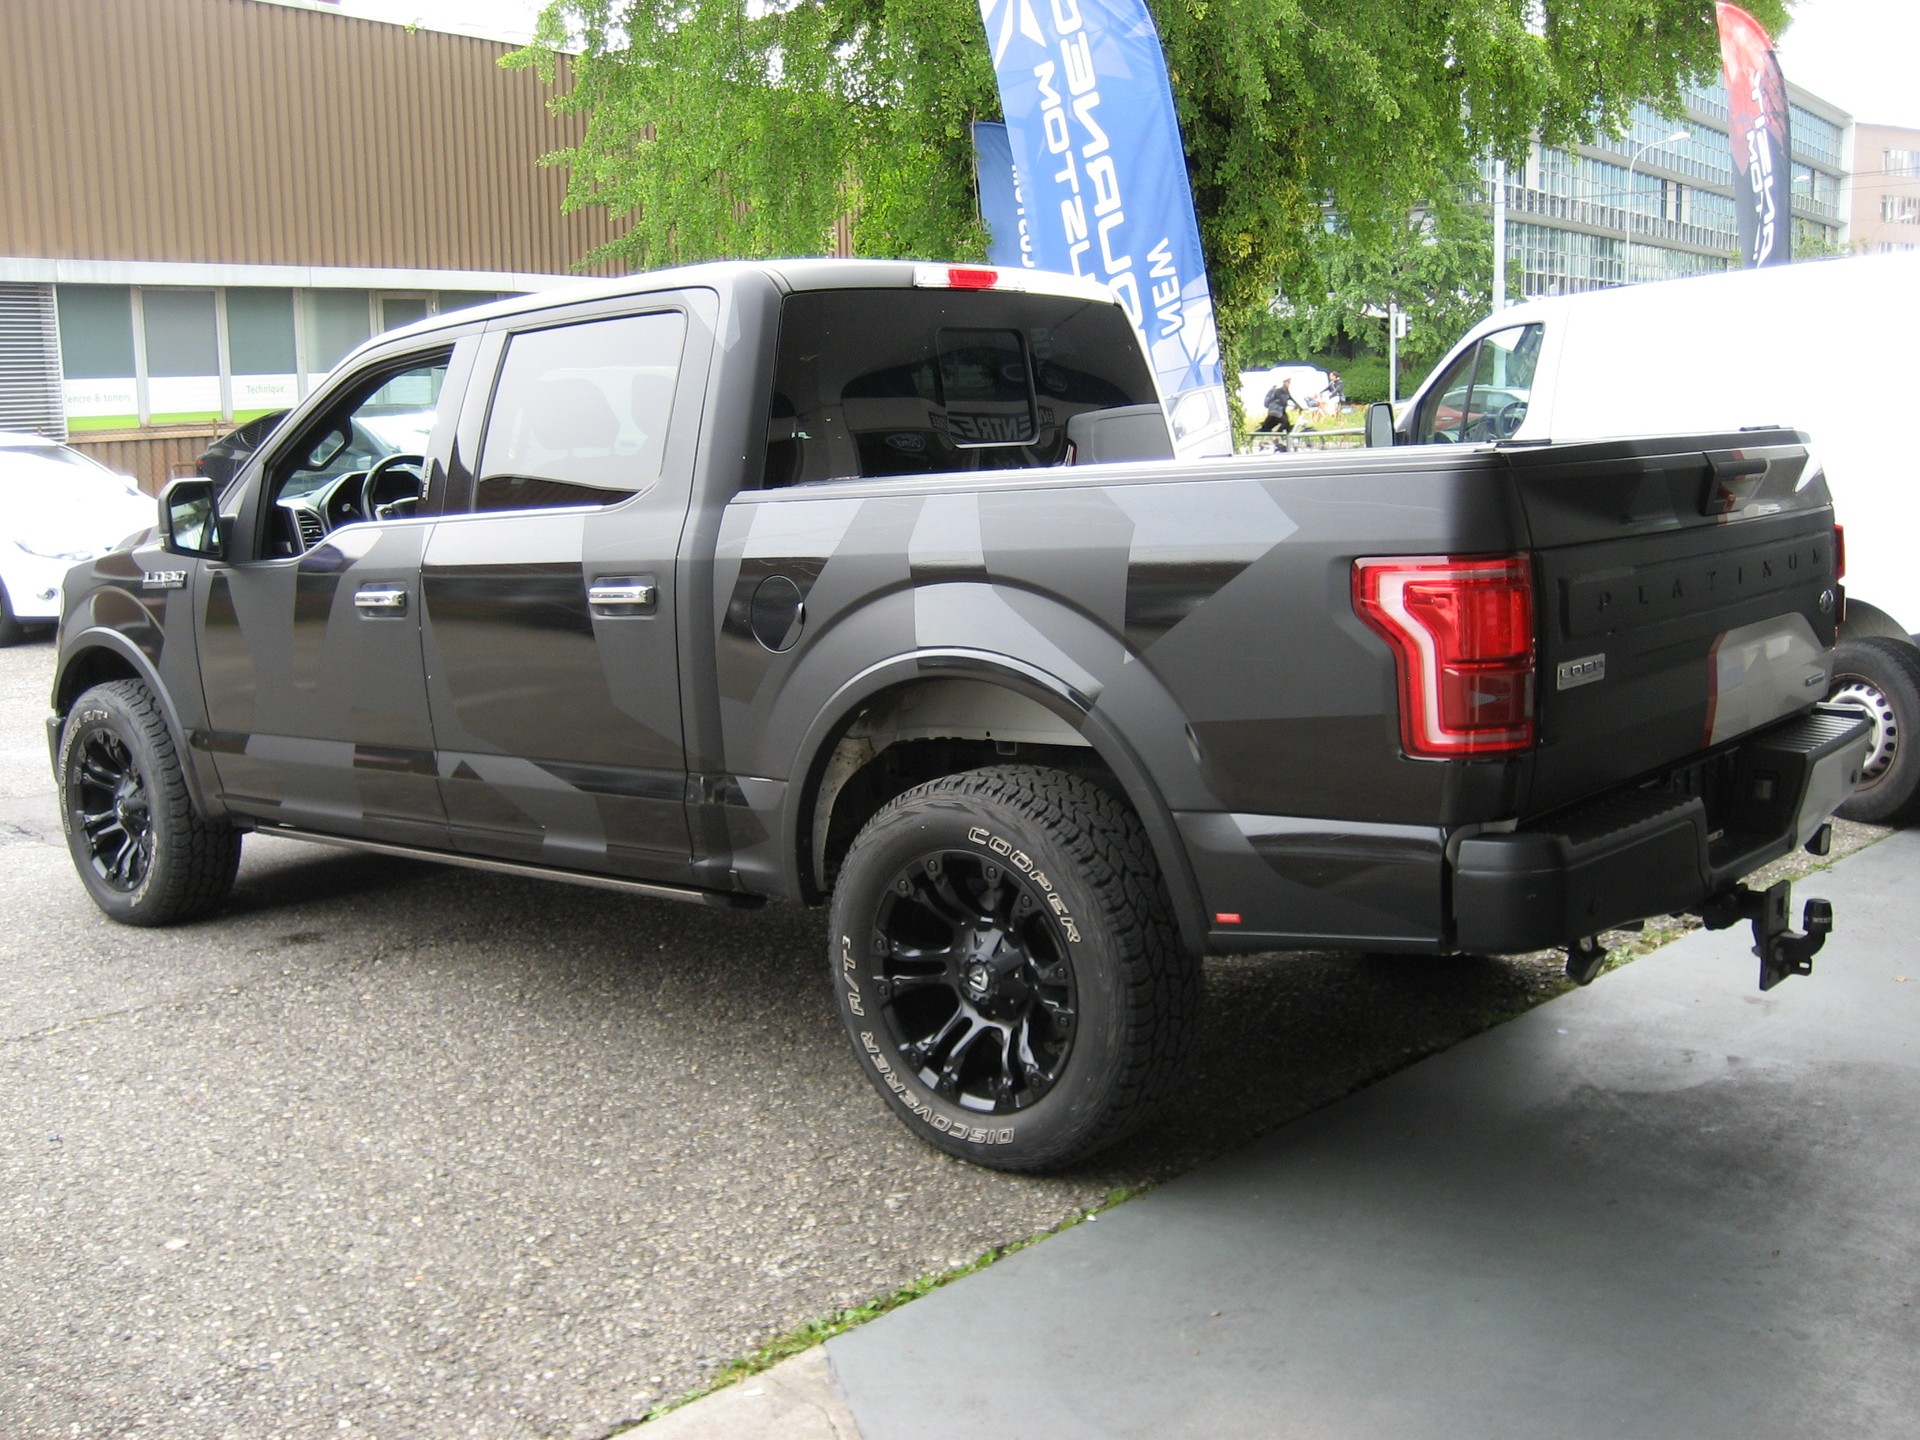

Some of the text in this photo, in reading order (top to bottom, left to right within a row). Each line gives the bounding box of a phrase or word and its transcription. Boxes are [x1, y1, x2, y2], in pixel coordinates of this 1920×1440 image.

[246, 384, 285, 394] Technique
[1599, 549, 1821, 611] PLATINUM
[969, 827, 1082, 944] COOPER
[861, 1031, 1015, 1145] DISCOVERER
